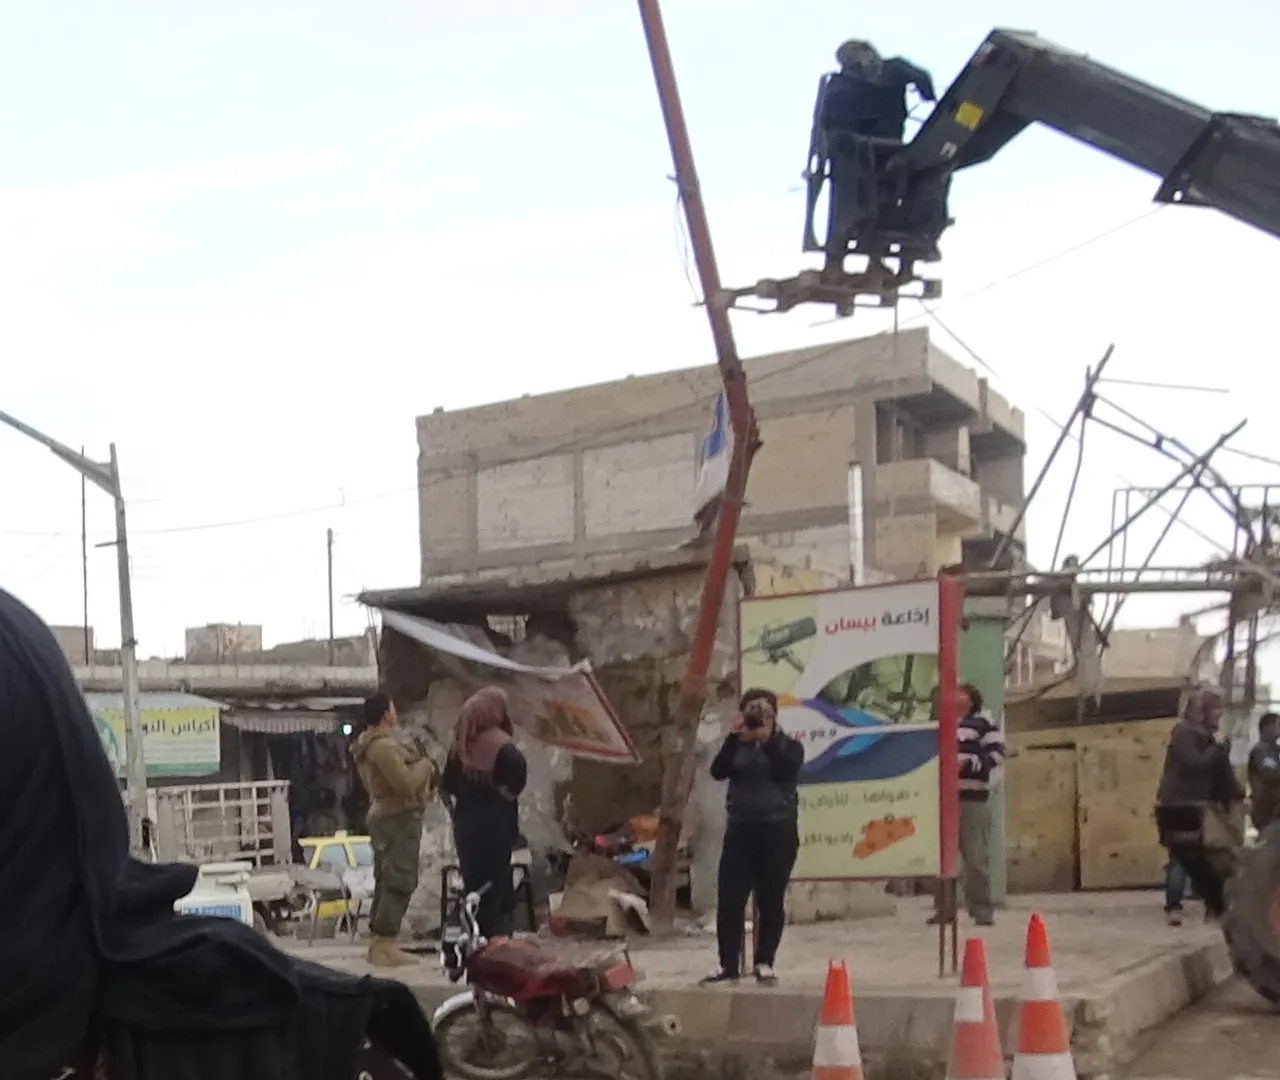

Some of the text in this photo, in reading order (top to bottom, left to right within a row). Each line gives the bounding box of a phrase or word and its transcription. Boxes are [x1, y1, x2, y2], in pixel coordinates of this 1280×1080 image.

[825, 607, 930, 635] إذاعة بيسان
[141, 719, 166, 735] النو
